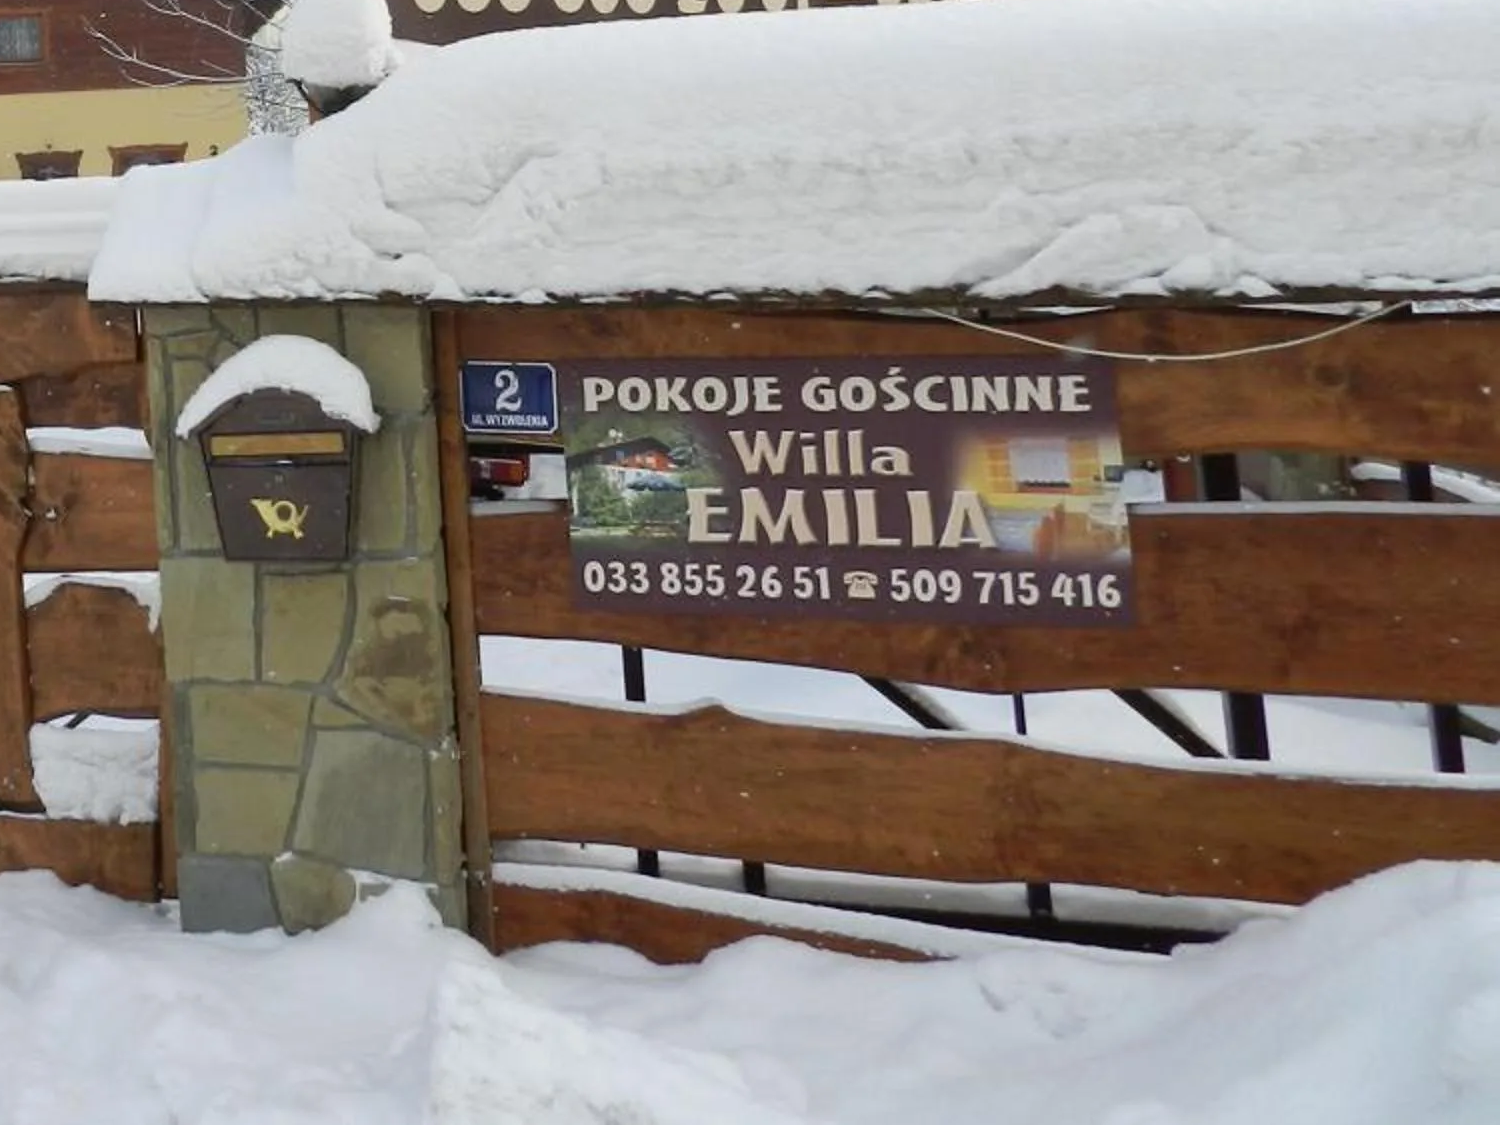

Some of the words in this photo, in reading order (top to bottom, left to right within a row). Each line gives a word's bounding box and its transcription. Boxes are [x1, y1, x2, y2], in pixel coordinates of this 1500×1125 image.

[495, 370, 522, 411] 2
[583, 376, 782, 416] POKOJE
[802, 368, 1092, 413] GOŚCINNE
[729, 429, 914, 477] Willa
[687, 487, 998, 548] EMILIA
[583, 561, 650, 593] 033
[660, 563, 726, 596] 855
[737, 565, 783, 598] 26
[793, 566, 831, 600] 51
[890, 568, 962, 603] 509
[973, 571, 1040, 605] 715
[1051, 573, 1122, 608] 416
